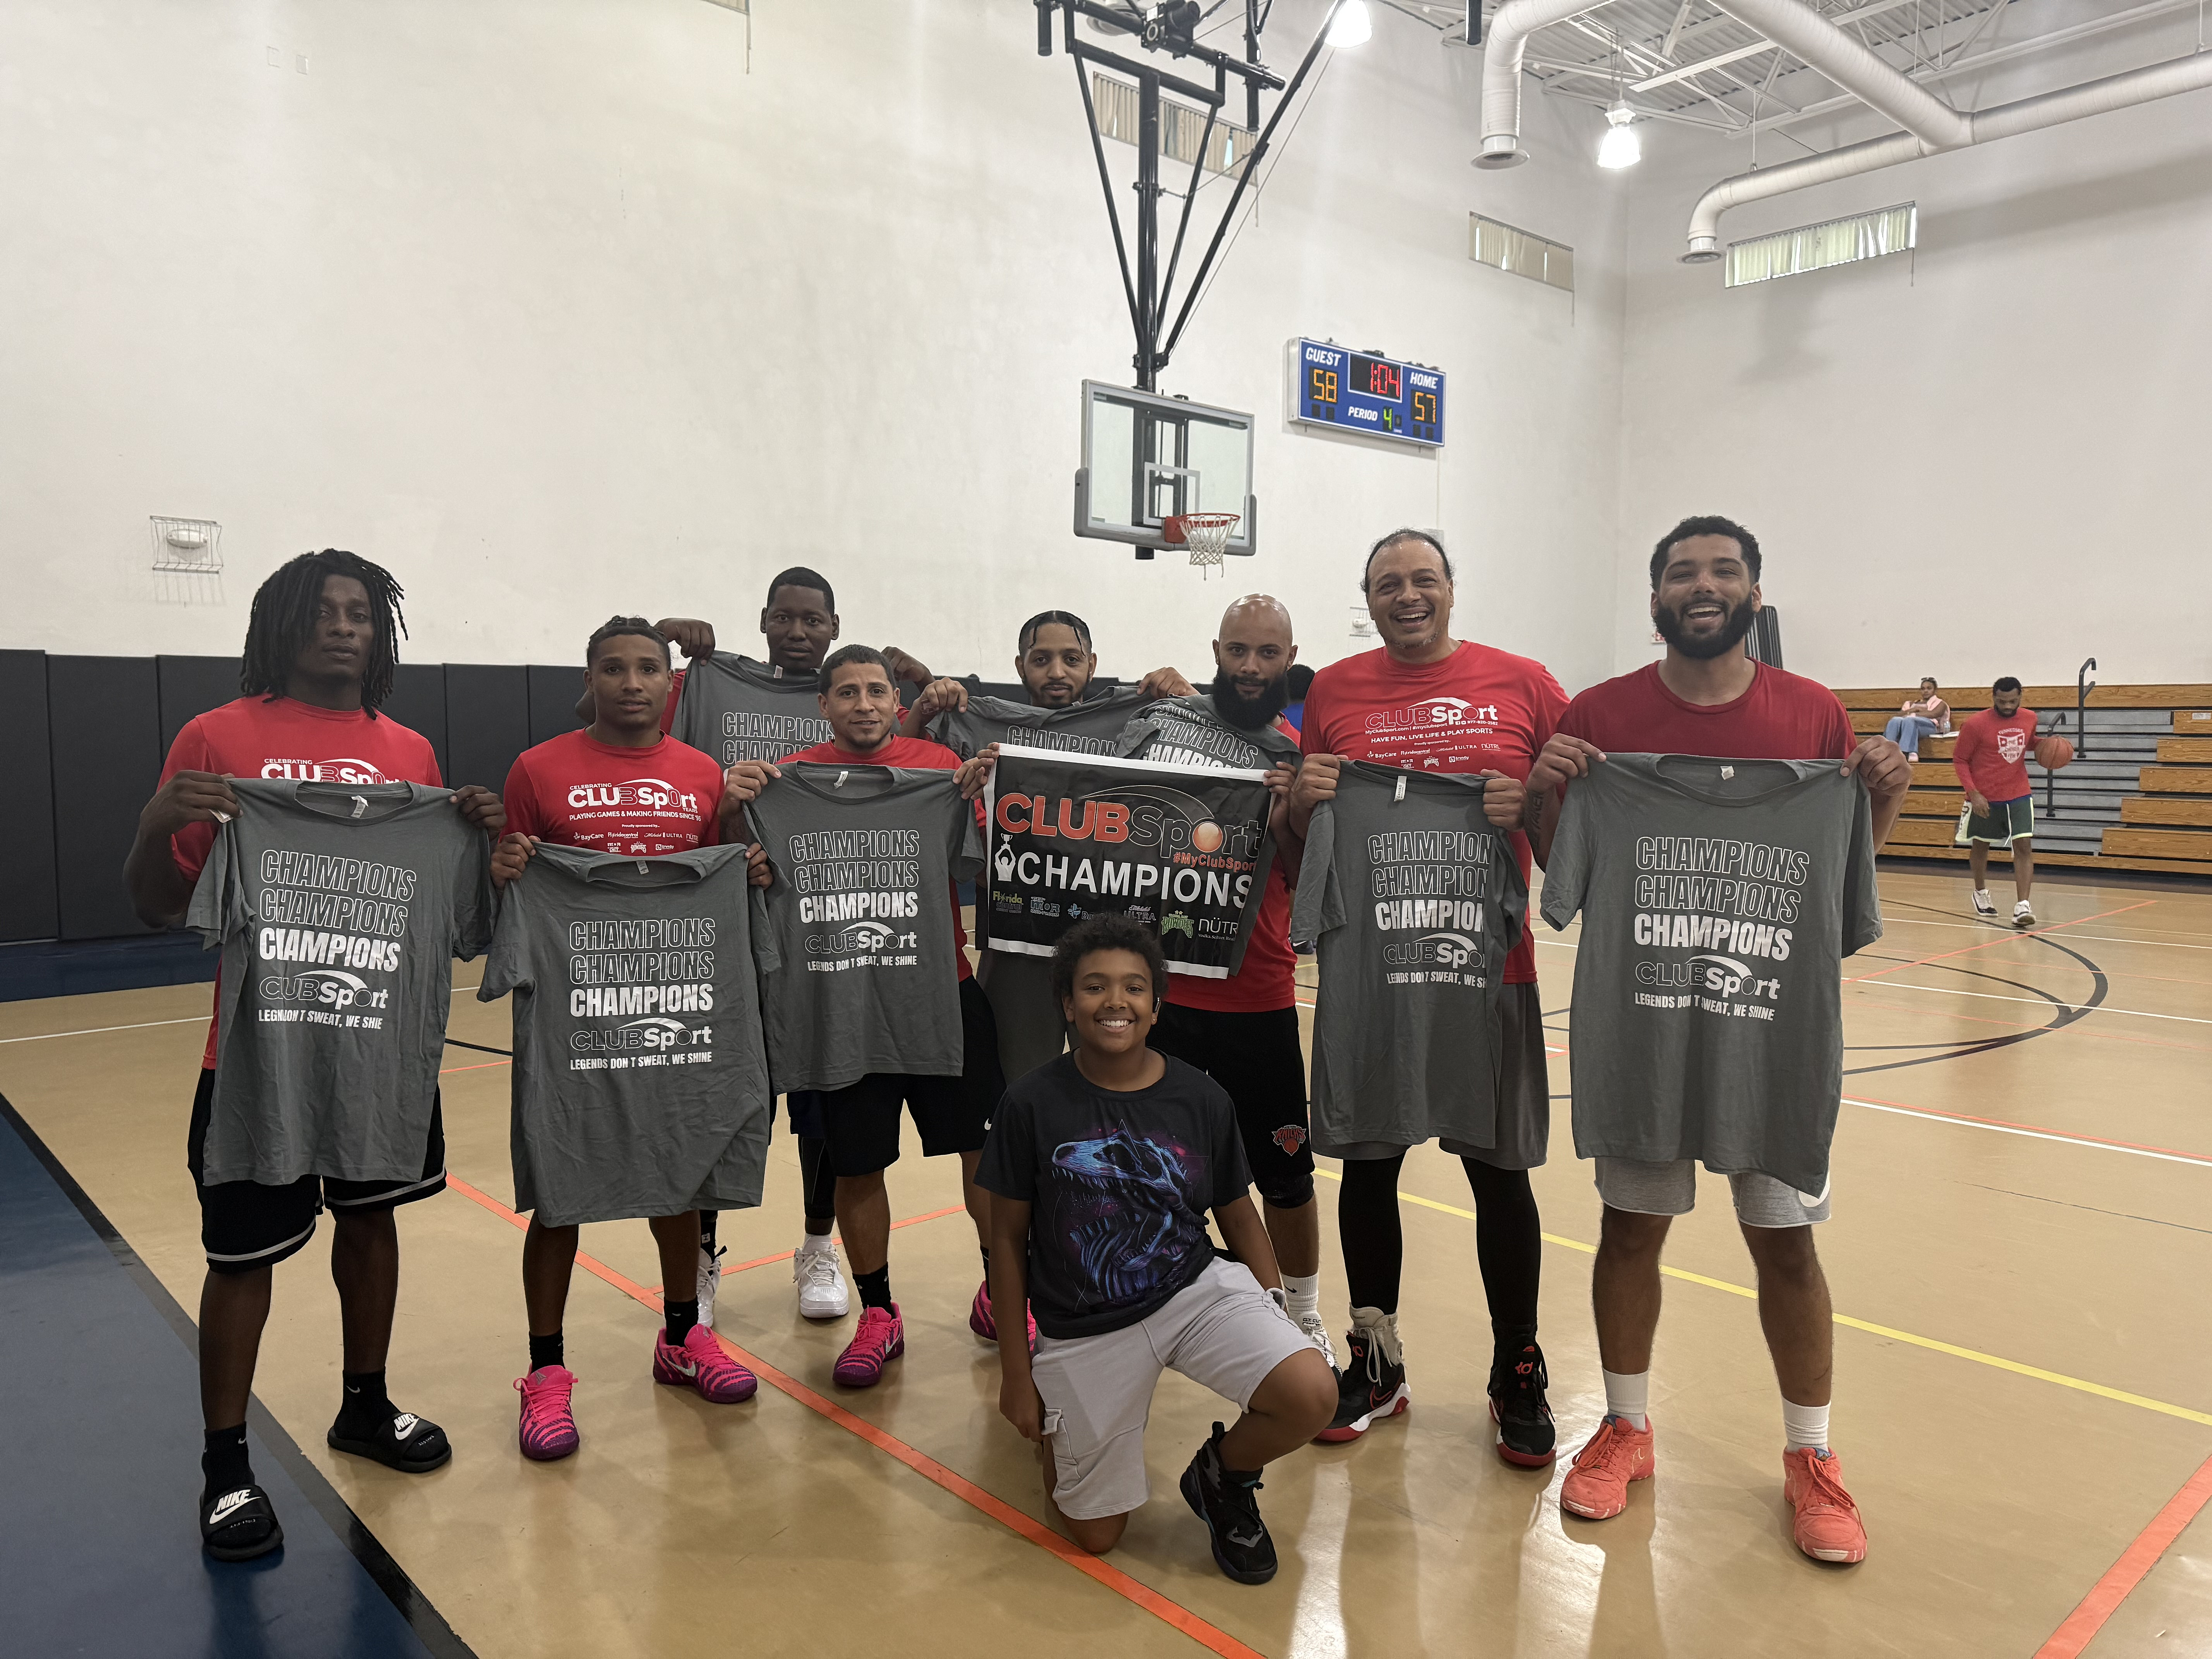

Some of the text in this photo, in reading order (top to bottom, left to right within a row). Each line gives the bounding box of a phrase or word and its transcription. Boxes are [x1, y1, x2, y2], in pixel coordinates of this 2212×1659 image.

[1305, 347, 1341, 366] GUEST
[1314, 369, 1337, 403] 58
[1370, 362, 1400, 397] 1:04
[1410, 372, 1438, 389] HOME
[1348, 406, 1378, 421] PERIOD
[1383, 408, 1392, 430] 4
[1415, 392, 1436, 424] 57
[1007, 725, 1116, 757] CHAMPION
[569, 812, 596, 821] PLAYING
[789, 830, 919, 863] CHAMPIONS
[1636, 836, 1810, 886] CHAMPIONS
[261, 849, 417, 902] CHAMPIONS
[794, 860, 919, 893] CHAMPIONS
[1017, 852, 1252, 908] CHAMPIONS
[260, 888, 408, 937] CHAMPIONS
[799, 891, 918, 923] CHAMPIONS
[1635, 874, 1801, 924] CHAMPIONS
[1124, 910, 1156, 921] ULTRA
[570, 918, 715, 951] CHAMPIONS
[1634, 913, 1793, 961] CHAMPIONS
[570, 951, 714, 984] CHAMPIONS
[881, 956, 893, 966] WE
[895, 955, 917, 966] SHINE
[1431, 971, 1461, 985] SWEAT,
[1464, 974, 1475, 986] WE
[570, 984, 713, 1017] CHAMPIONS
[1635, 992, 1675, 1008] LEGENDS
[1733, 1004, 1747, 1017] WE
[1748, 1005, 1775, 1021] SHINE
[307, 1010, 342, 1028] SWEAT,
[345, 1015, 361, 1027] WE
[570, 1058, 608, 1070] LEGENDS
[638, 1054, 670, 1067] SWEAT,
[672, 1054, 685, 1065] WE
[688, 1051, 712, 1063] SHINE
[1274, 1127, 1305, 1144] KNICKS
[394, 1413, 417, 1431] NIKE
[215, 1489, 251, 1513] NIKE
